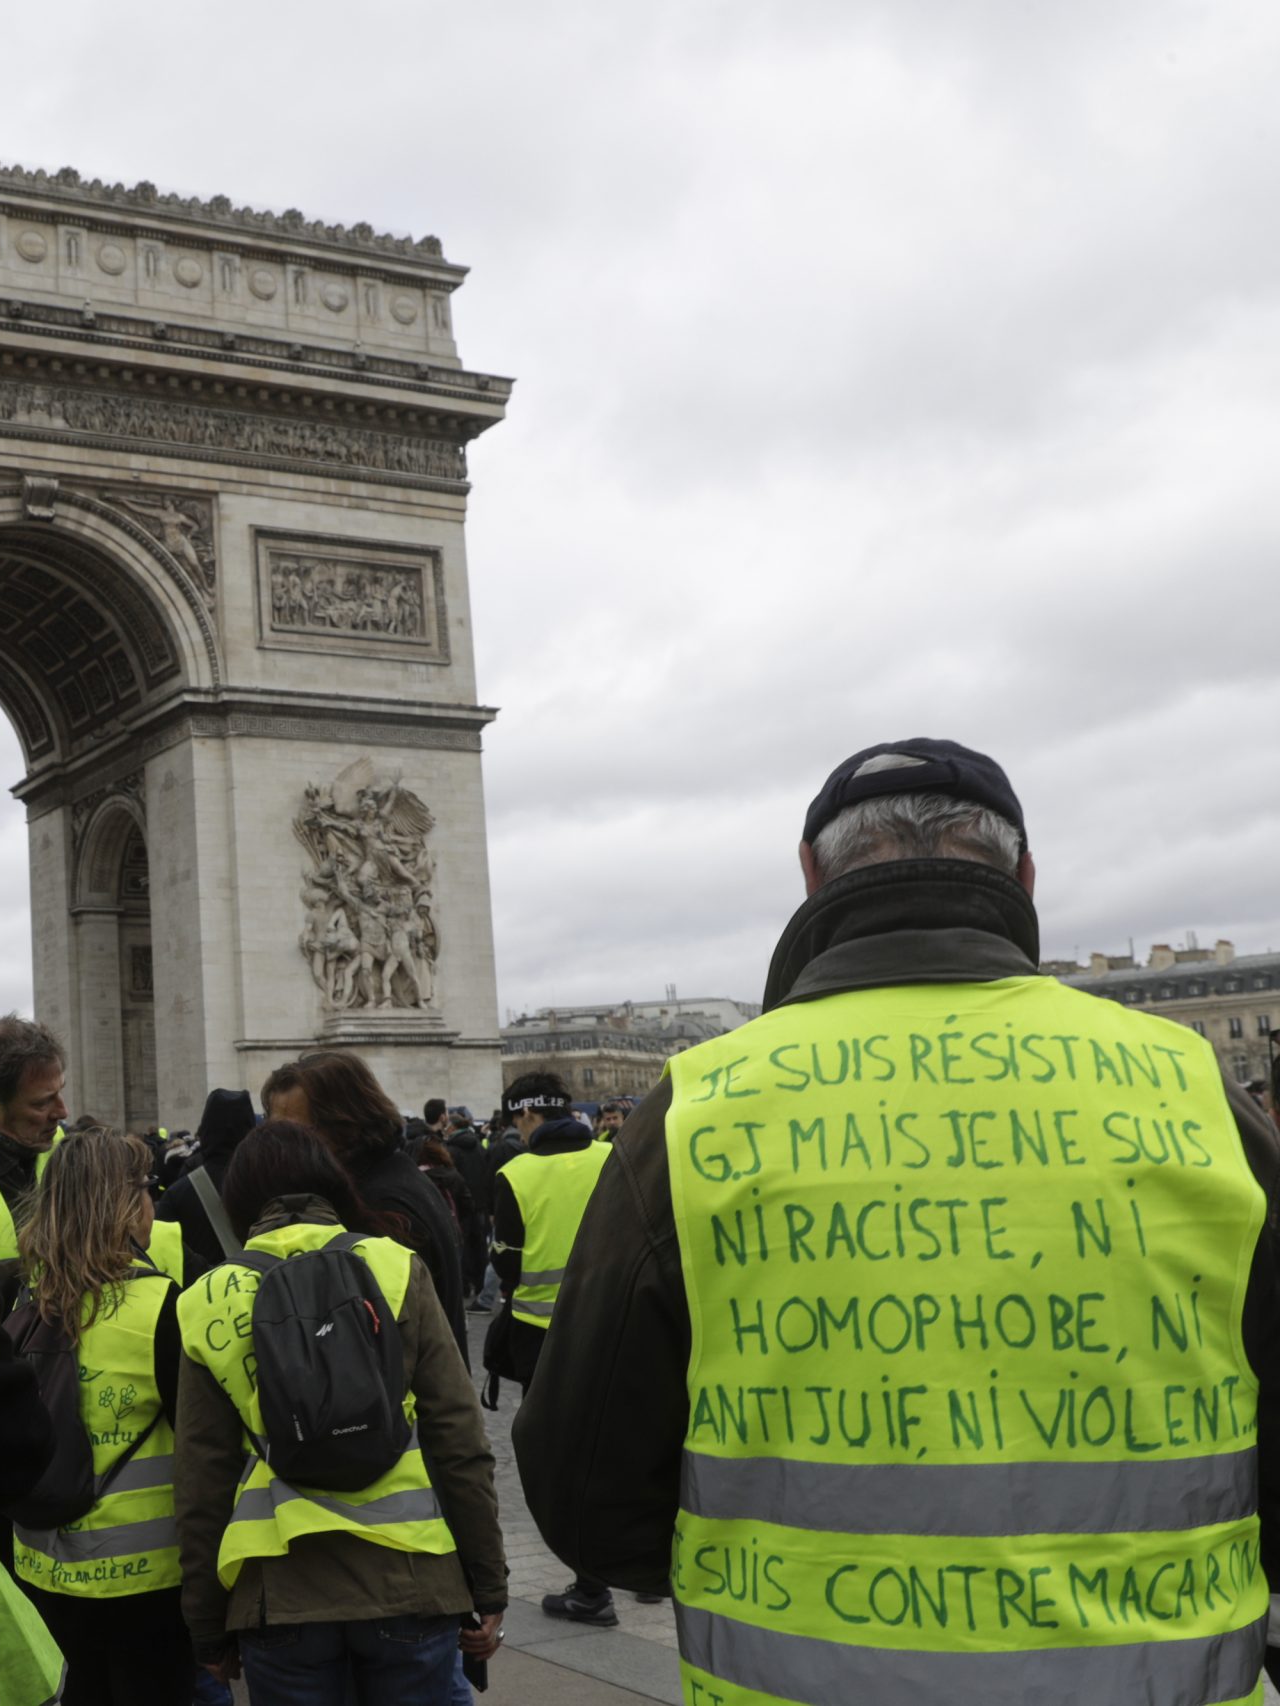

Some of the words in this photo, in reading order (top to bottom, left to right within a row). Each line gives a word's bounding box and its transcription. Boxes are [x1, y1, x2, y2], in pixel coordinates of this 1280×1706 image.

[691, 1056, 761, 1102] JE
[770, 1035, 896, 1092] SUIS
[825, 1564, 1060, 1631] CONTRE
[1070, 1538, 1261, 1629] MACARON
